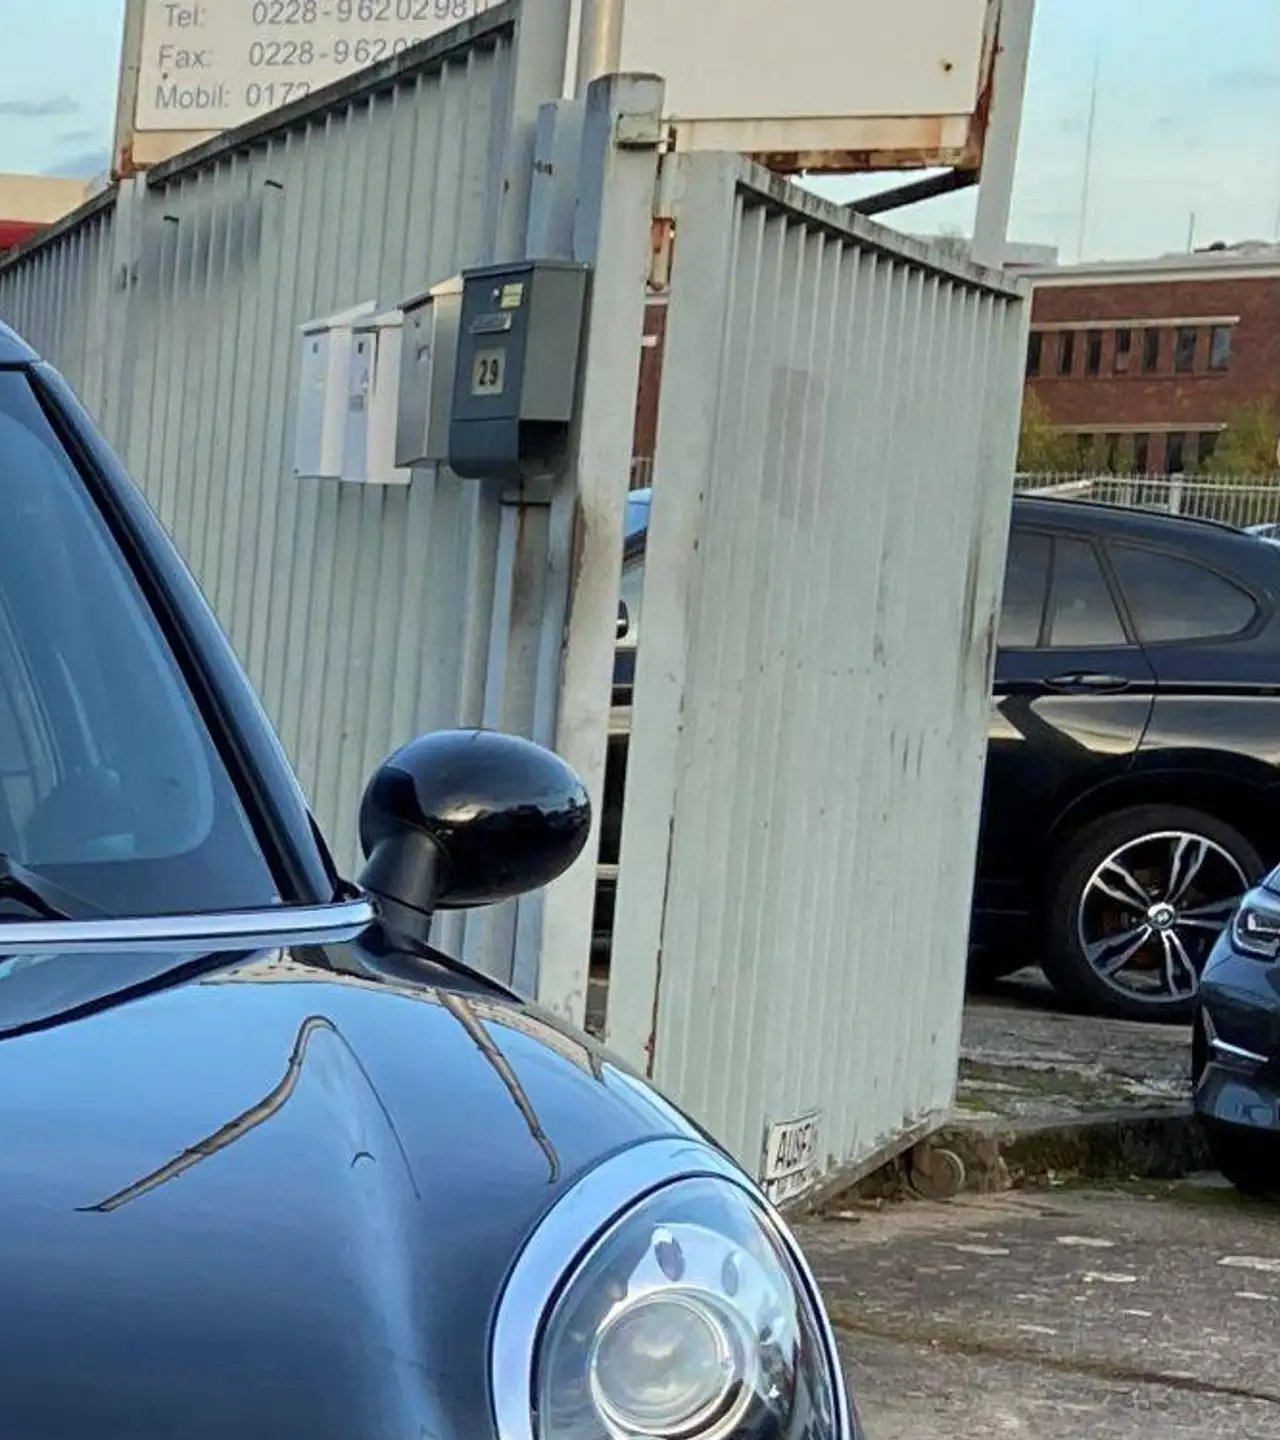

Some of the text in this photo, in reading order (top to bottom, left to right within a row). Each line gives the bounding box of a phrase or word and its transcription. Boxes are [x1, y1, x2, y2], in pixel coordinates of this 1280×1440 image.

[164, 3, 207, 28] Tel:
[154, 84, 232, 109] Mobil:
[479, 359, 499, 386] 29
